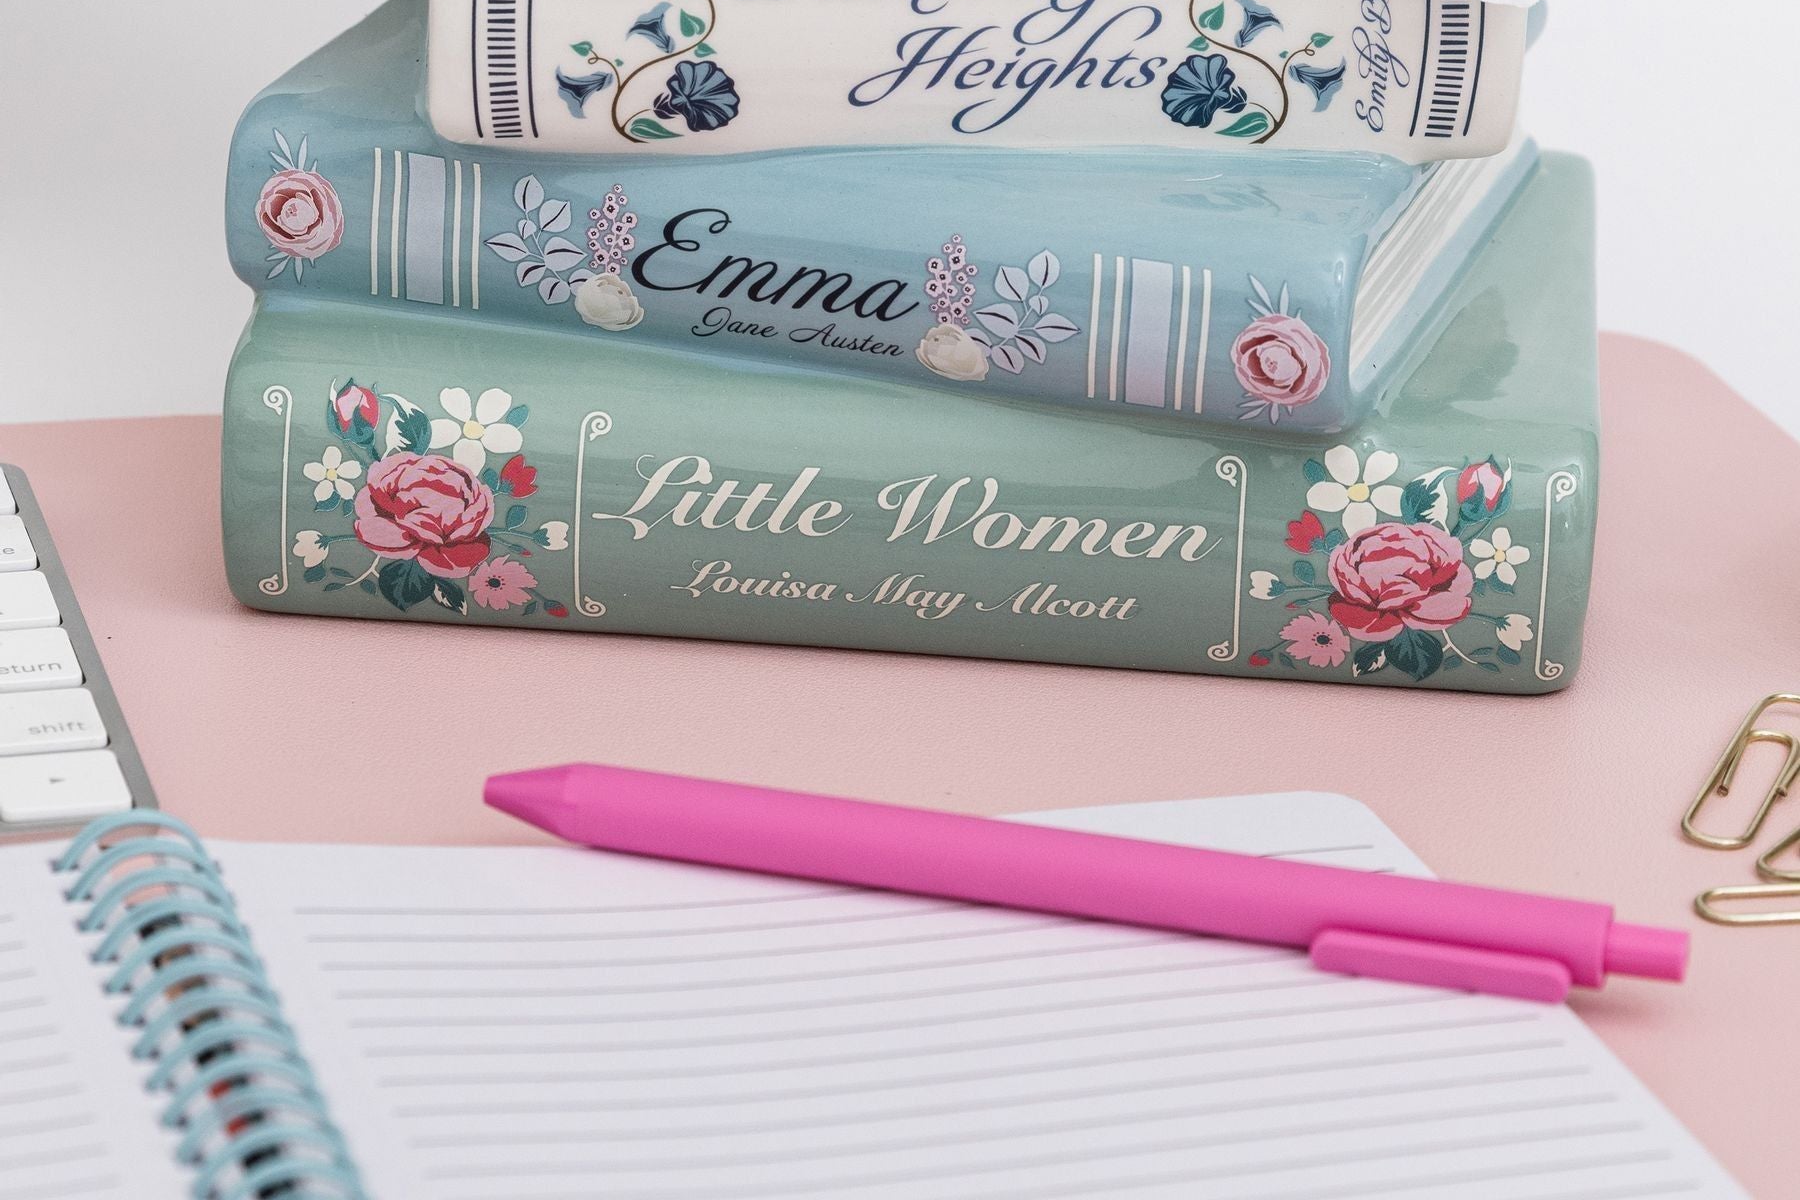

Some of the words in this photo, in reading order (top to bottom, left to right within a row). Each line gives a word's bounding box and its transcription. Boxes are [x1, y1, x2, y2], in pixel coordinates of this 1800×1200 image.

[847, 5, 1168, 134] Heights
[1351, 26, 1411, 133] Emily
[631, 207, 920, 322] Emma
[691, 306, 779, 337] Jane
[788, 322, 904, 357] Austen
[591, 454, 854, 540] Little
[876, 473, 1223, 563] Women
[669, 559, 838, 601] Louisa
[845, 572, 967, 620] May
[975, 582, 1139, 621] Alcott
[0, 661, 63, 676] eturn
[27, 718, 87, 736] shift
